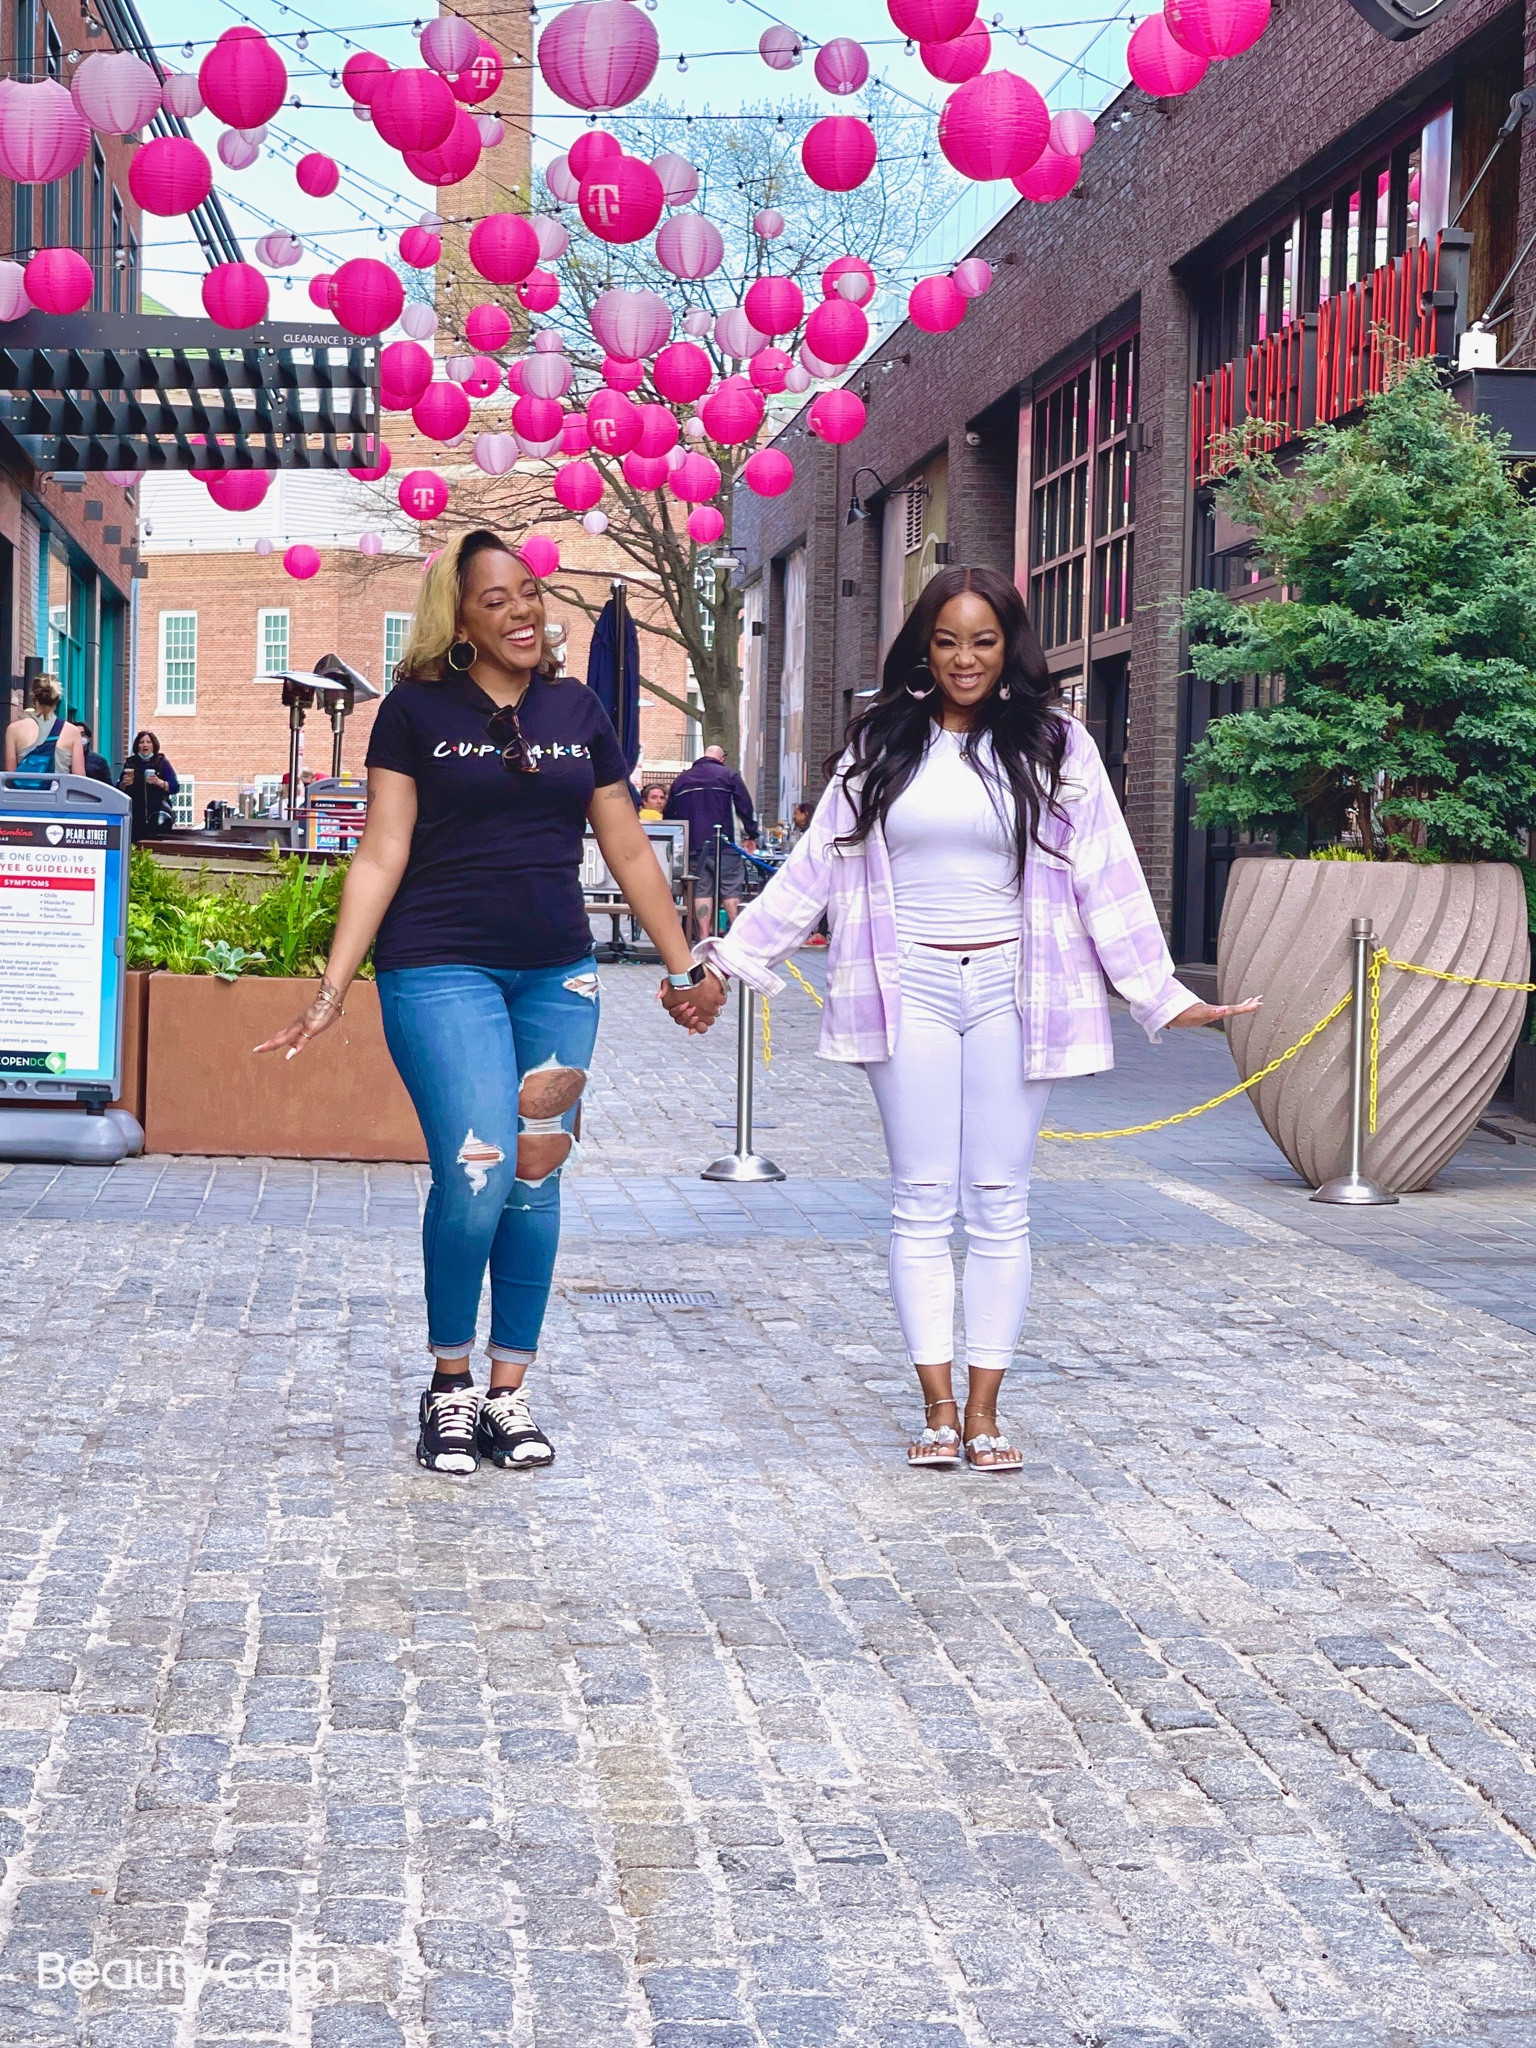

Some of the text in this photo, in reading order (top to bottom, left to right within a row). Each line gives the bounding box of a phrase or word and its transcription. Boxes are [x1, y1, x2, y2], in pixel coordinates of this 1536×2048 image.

[588, 184, 621, 227] T
[283, 334, 339, 345] CLEARANCE
[413, 488, 435, 512] T
[66, 828, 107, 840] PEARL STREET
[9, 852, 31, 861] ONE
[35, 854, 84, 863] COVID-19
[26, 864, 97, 875] GUIDELINES
[4, 879, 50, 887] SYMPTOMS
